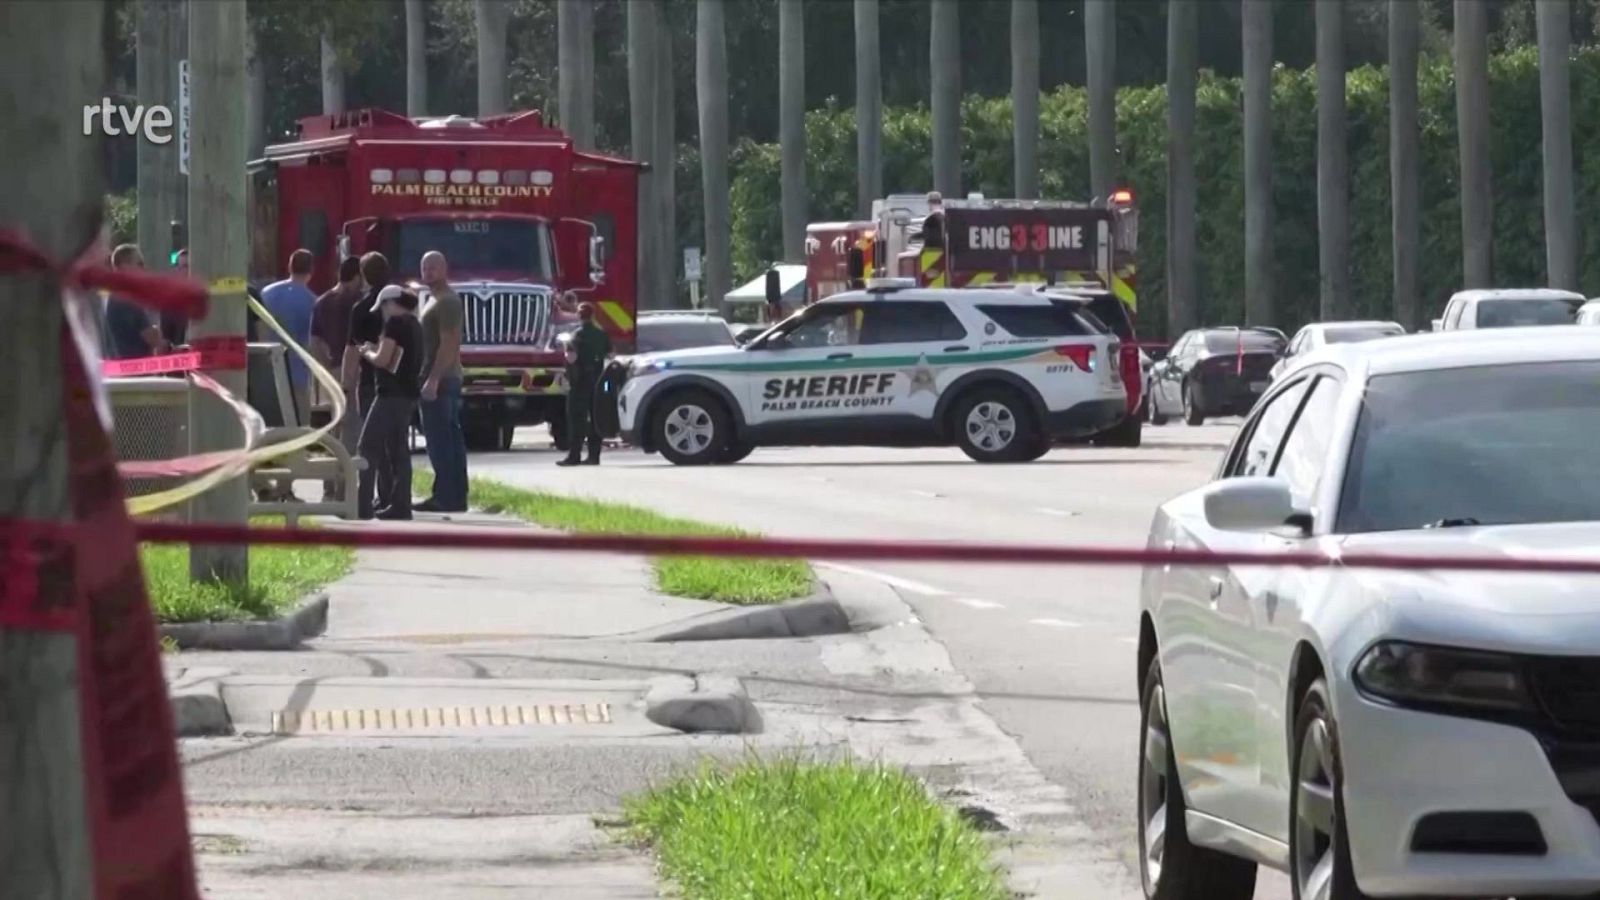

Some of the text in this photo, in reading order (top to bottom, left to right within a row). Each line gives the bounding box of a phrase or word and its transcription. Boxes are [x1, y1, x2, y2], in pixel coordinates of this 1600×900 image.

[371, 184, 554, 197] PALM BEACH COUNTY
[762, 373, 896, 400] SHERIFF
[761, 396, 895, 412] PALM BEACH COUNTY
